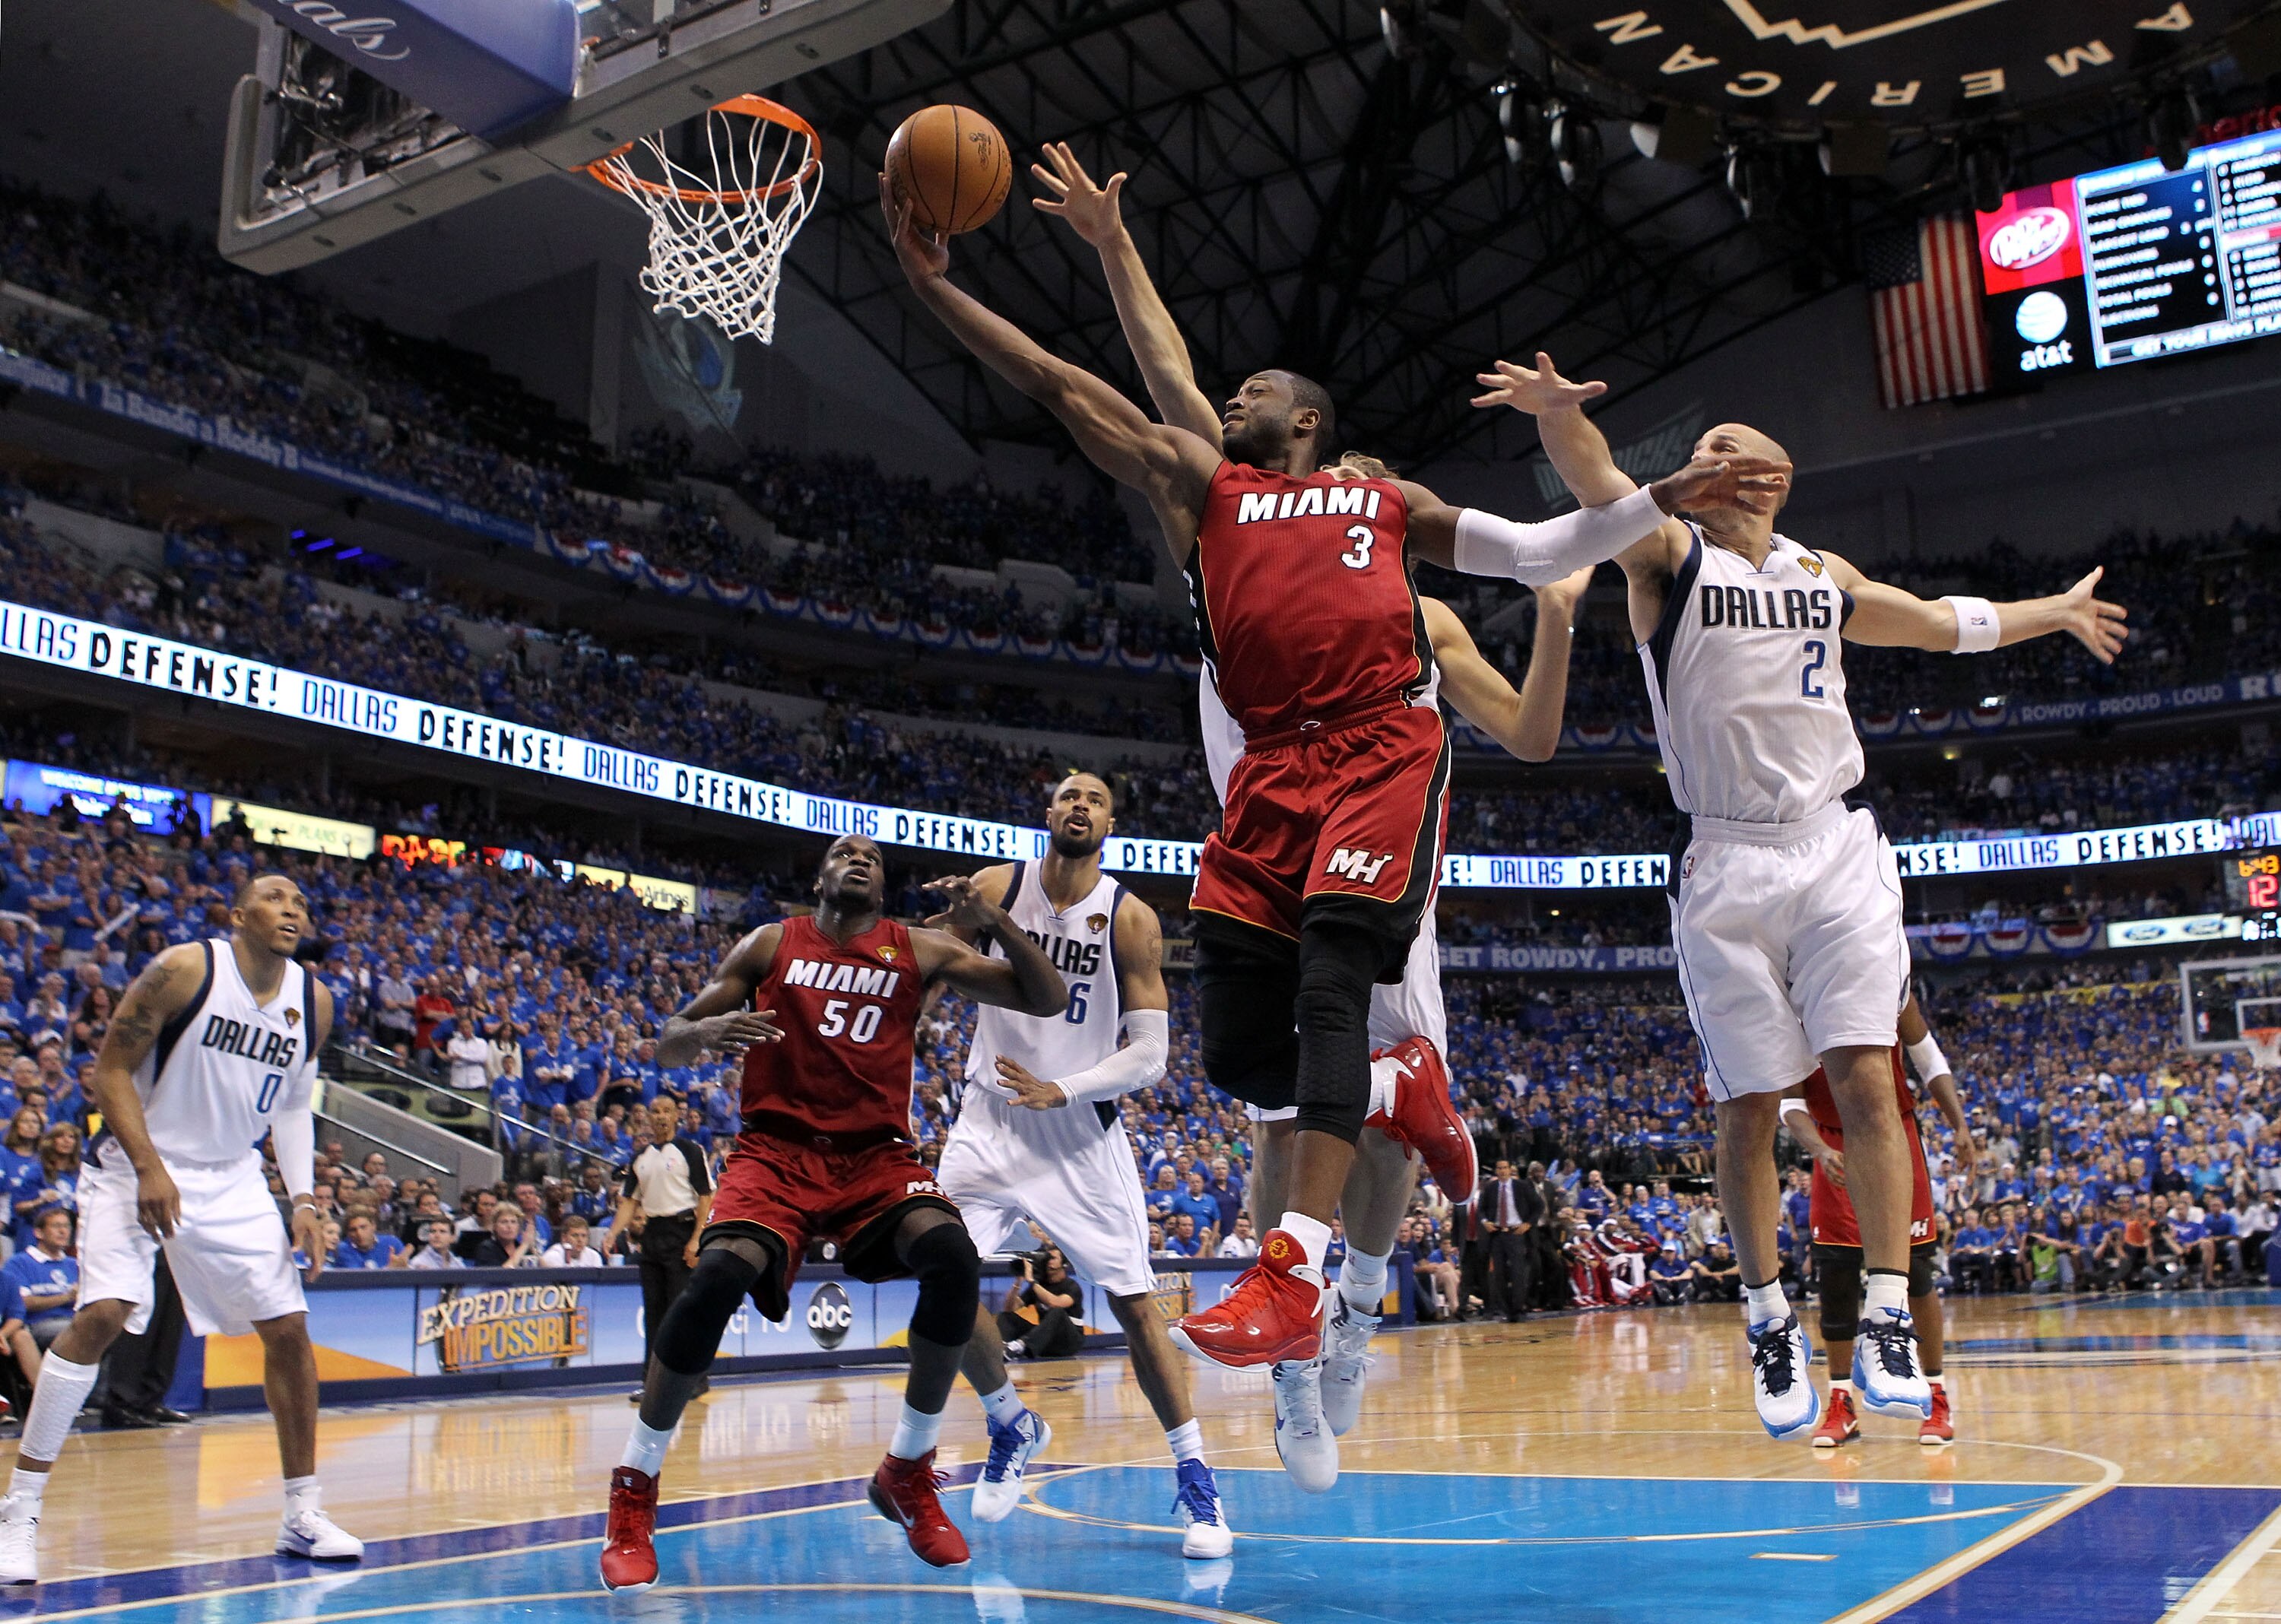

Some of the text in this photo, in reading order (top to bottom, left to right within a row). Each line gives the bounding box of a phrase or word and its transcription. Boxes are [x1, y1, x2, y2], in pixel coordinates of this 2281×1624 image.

[2020, 340, 2073, 372] at&t
[1236, 487, 1382, 525] MIAMI
[1340, 524, 1375, 570] 3
[1701, 585, 1832, 630] DALLAS
[1800, 639, 1826, 700] 2
[2172, 684, 2224, 706] LOUD
[88, 632, 278, 706] DEFENSE!
[303, 679, 398, 733] DALLAS
[419, 709, 564, 771] DEFENSE!
[584, 746, 659, 792] DALLAS
[676, 768, 792, 823] DEFENSE!
[806, 798, 878, 836] DALLAS
[896, 813, 1017, 857] DEFENSE!
[1978, 839, 2058, 868] DALLAS
[2077, 822, 2218, 862] DEFENSE!
[1490, 859, 1563, 885] DALLAS
[783, 958, 900, 998] MIAMI
[817, 999, 883, 1044] 50
[1065, 982, 1092, 1026] 6
[201, 1013, 298, 1067] DALLAS
[256, 1073, 284, 1114] 0
[418, 1284, 580, 1346] EXPEDITION
[807, 1296, 852, 1330] abc
[444, 1311, 588, 1369] IMPOSSIBLE
